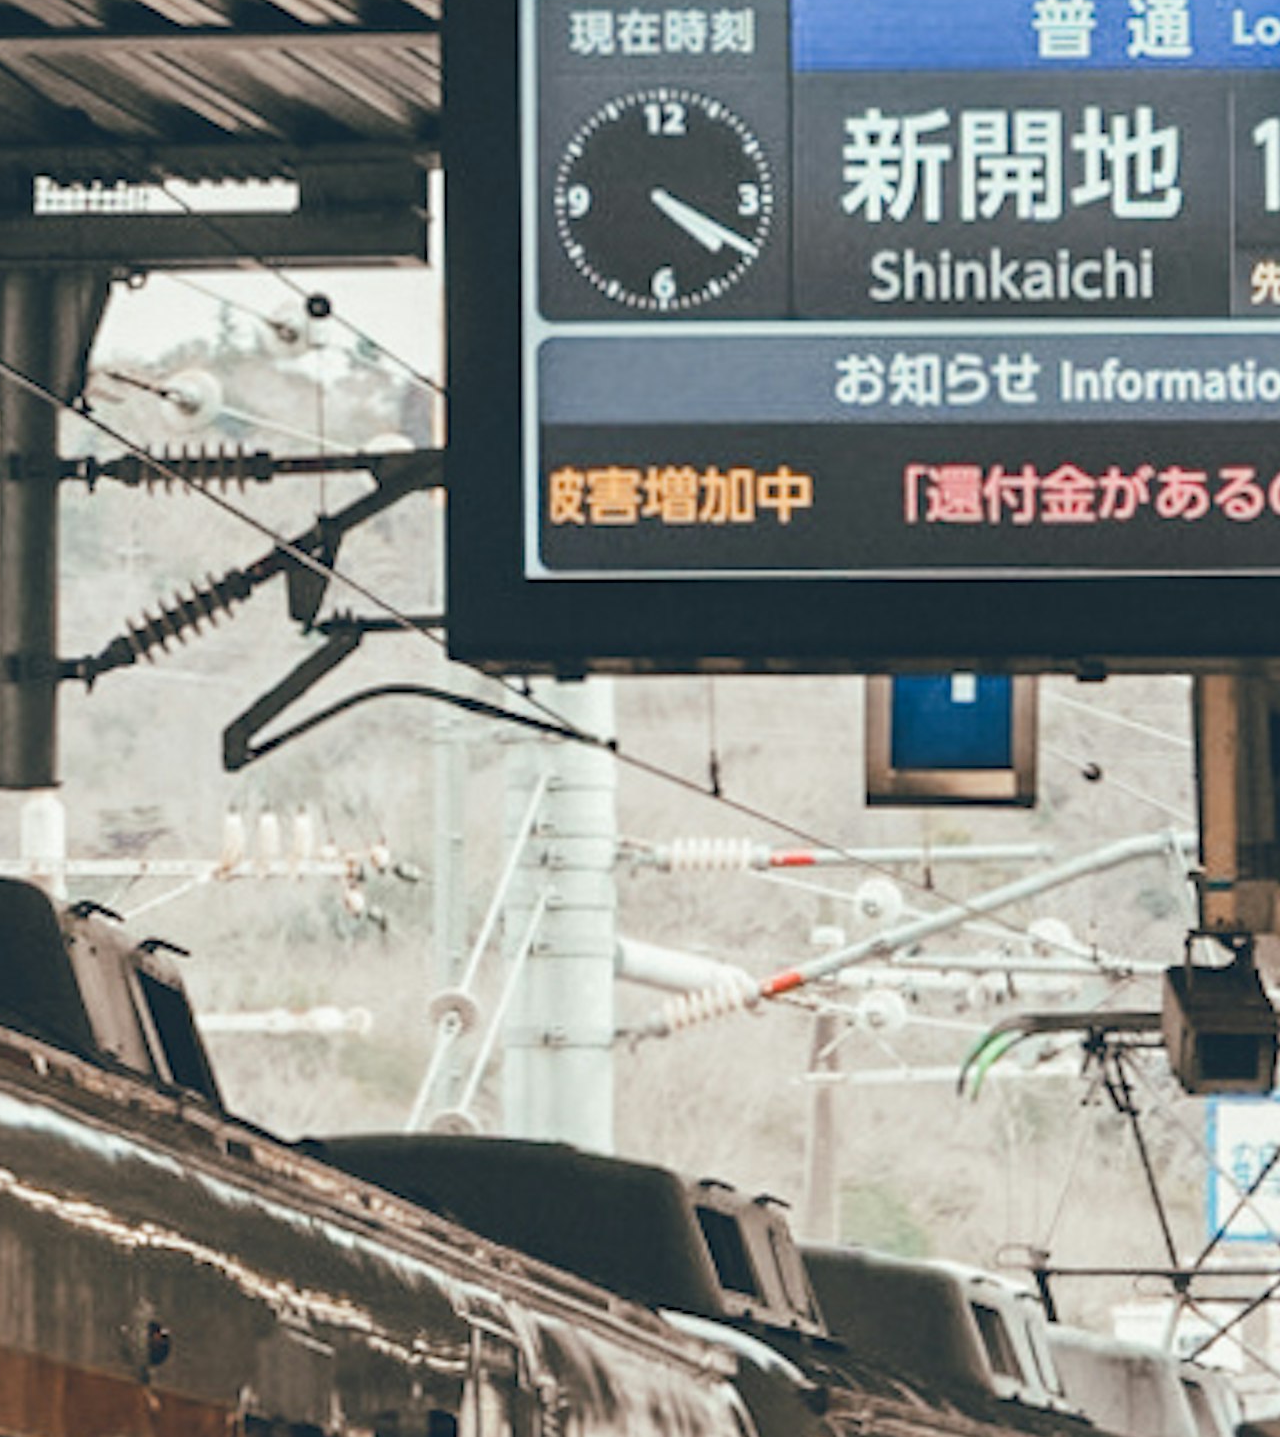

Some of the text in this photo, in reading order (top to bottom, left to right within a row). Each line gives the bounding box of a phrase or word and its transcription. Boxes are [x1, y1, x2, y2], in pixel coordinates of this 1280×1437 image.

[568, 8, 755, 55] 現在時刻
[643, 103, 688, 136] 12
[841, 107, 1183, 223] 新開地
[568, 184, 591, 218] 9
[737, 182, 760, 216] 3
[652, 266, 676, 300] 6
[868, 248, 1154, 302] Shinkaichi
[835, 352, 1041, 406] お知らせ
